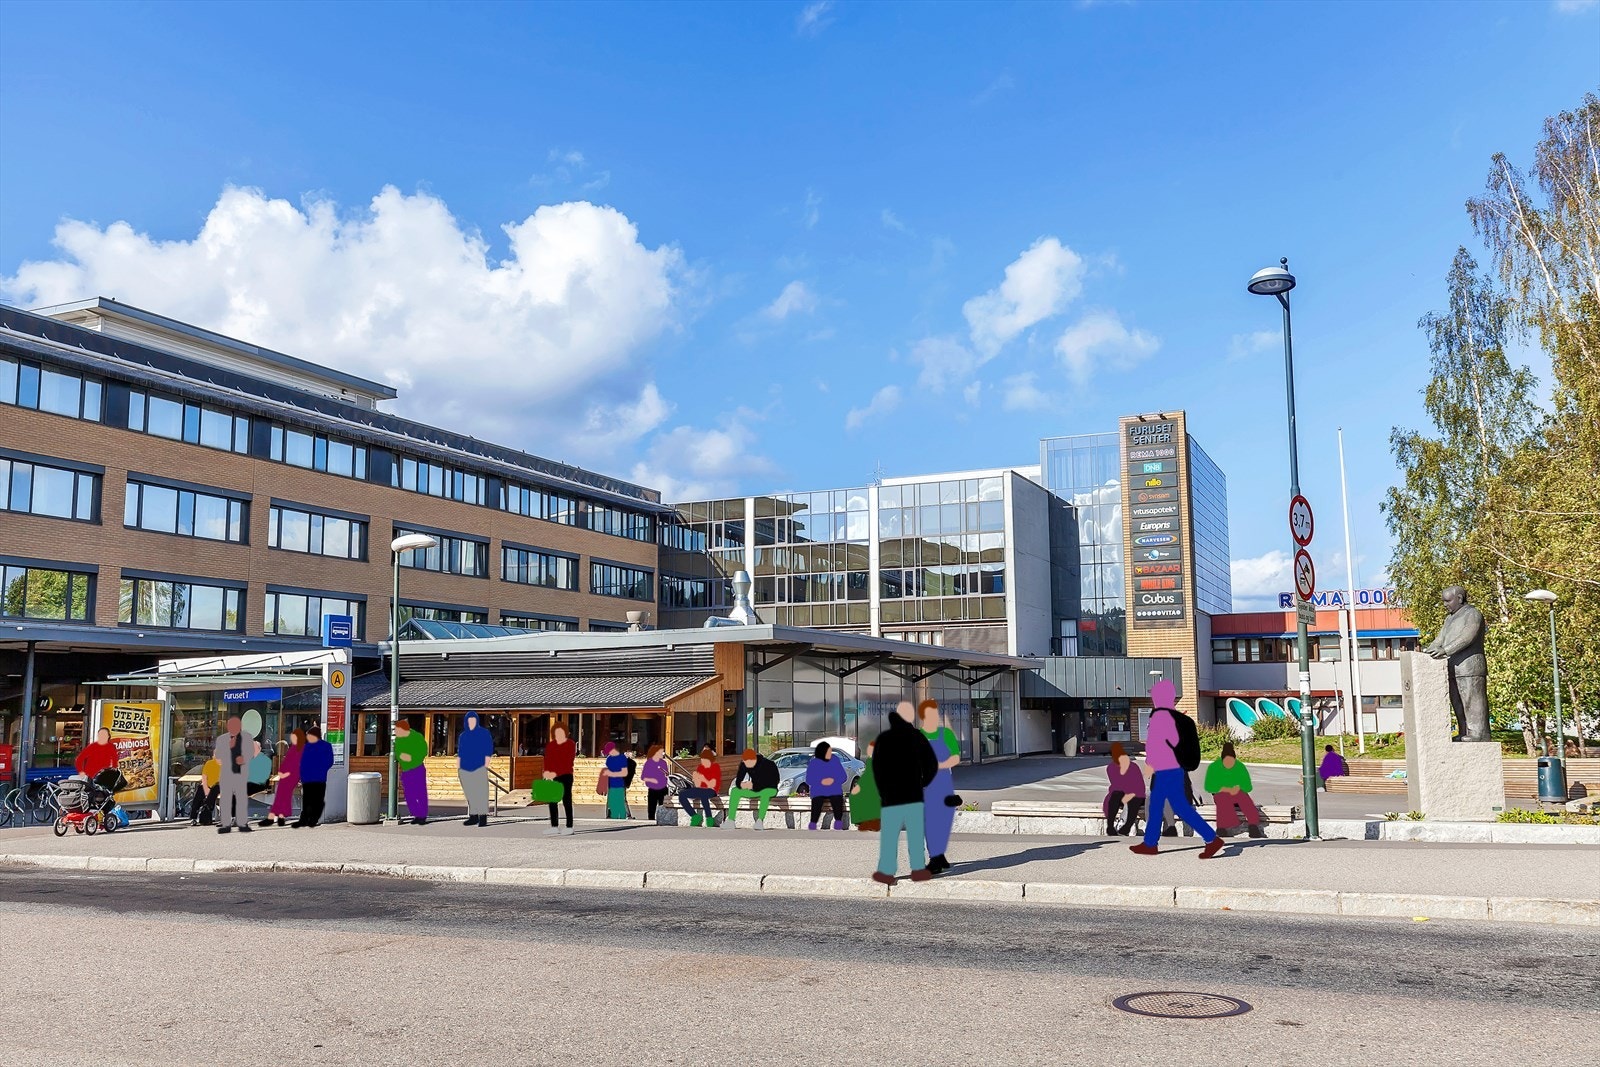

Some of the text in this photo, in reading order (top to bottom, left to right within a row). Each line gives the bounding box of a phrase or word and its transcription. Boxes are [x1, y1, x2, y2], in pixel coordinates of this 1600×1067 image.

[1129, 423, 1174, 436] FURUSET
[1133, 433, 1171, 445] SENTER
[1130, 448, 1175, 459] REMA 1000
[1145, 463, 1160, 472] DNB
[1145, 478, 1162, 487] nille
[1293, 512, 1305, 528] 3,7
[1140, 522, 1171, 531] Europris
[1143, 564, 1181, 574] BAZAAR
[1142, 593, 1174, 604] Cubus
[1280, 591, 1343, 608] RMA
[334, 674, 341, 685] A
[223, 690, 249, 700] Furuset T
[113, 710, 145, 722] UTE PÅ
[112, 717, 150, 731] PRØVE!
[113, 739, 149, 750] RANDIOSA
